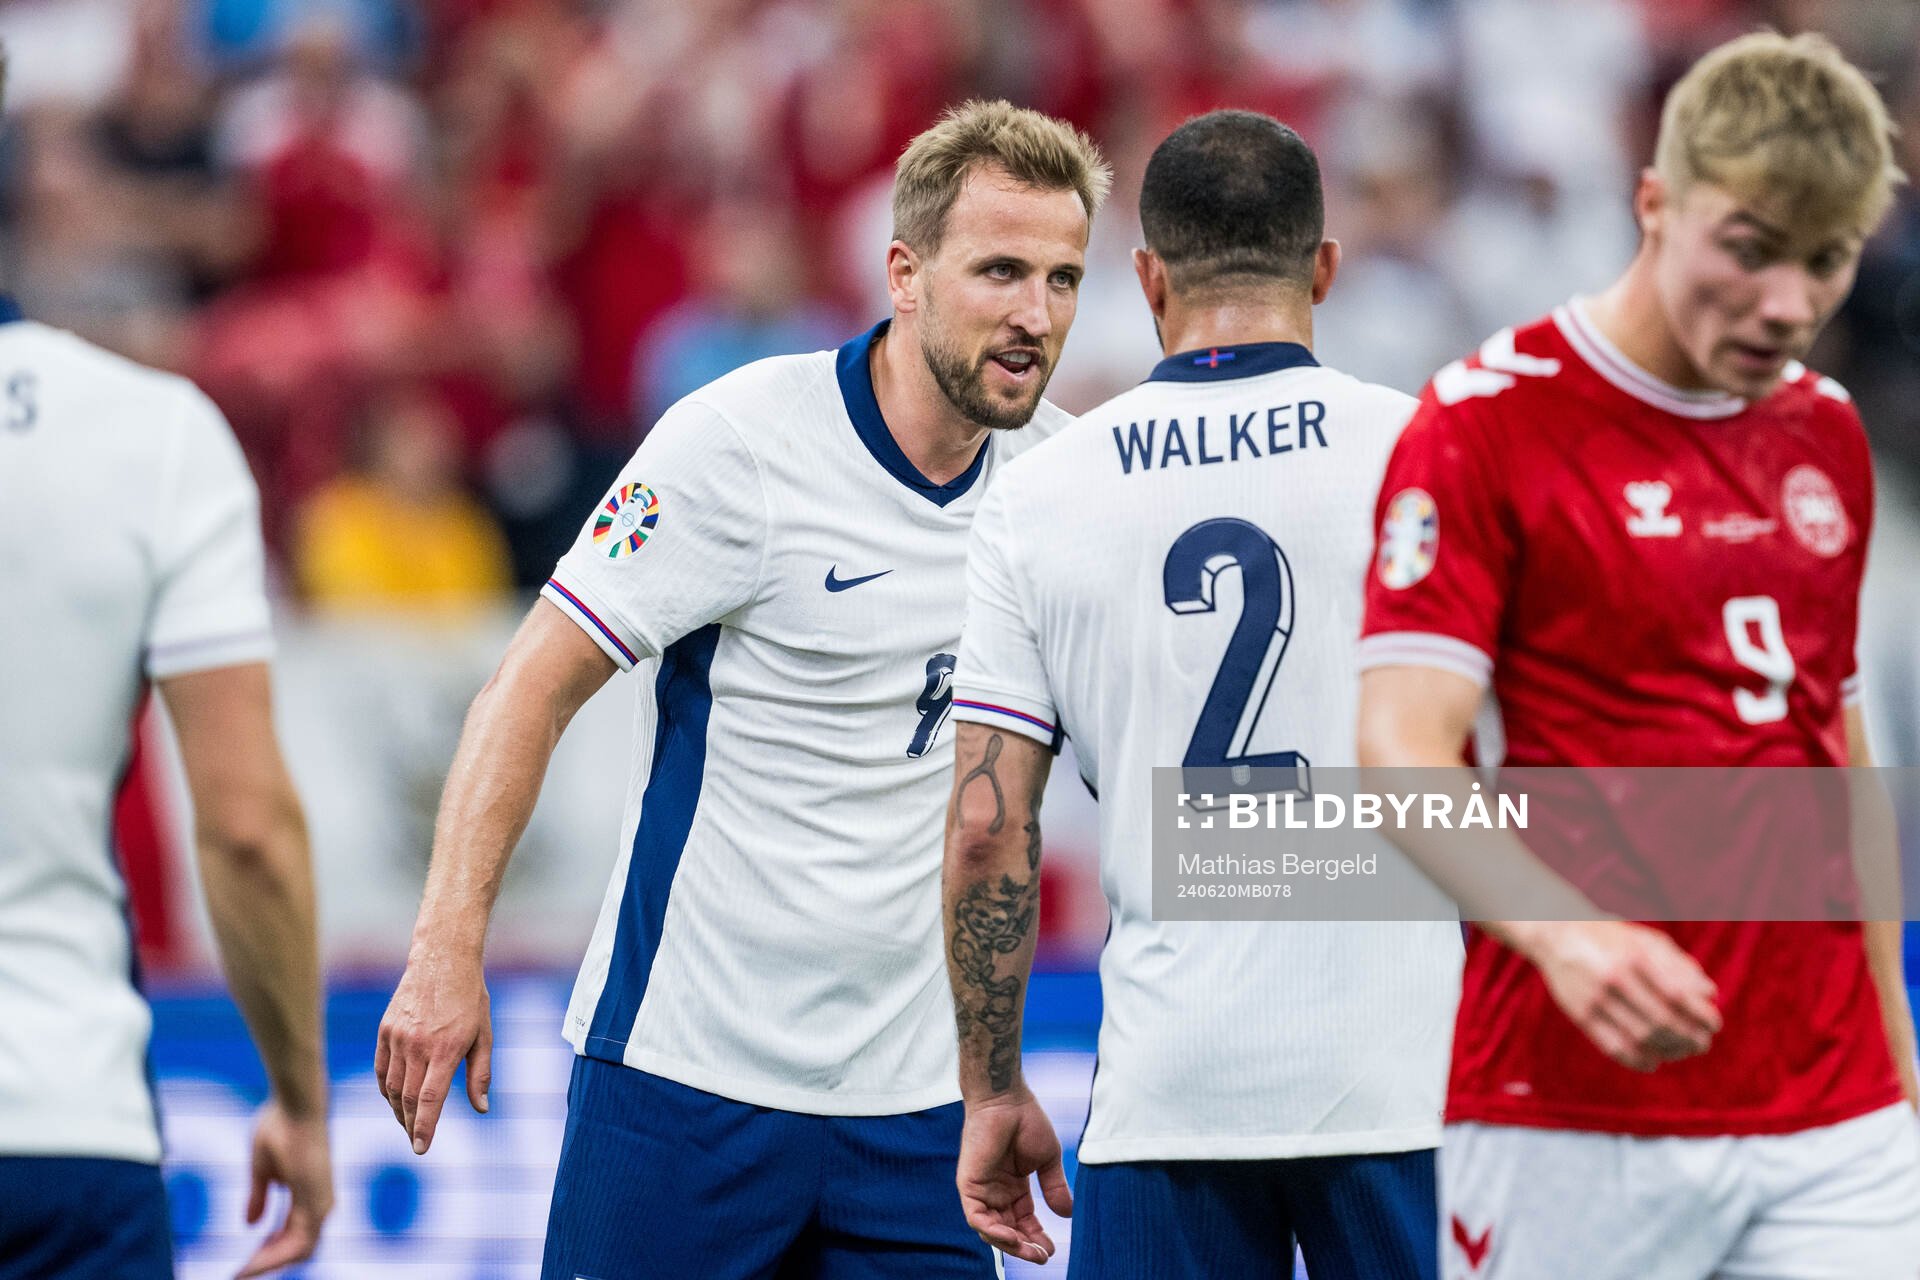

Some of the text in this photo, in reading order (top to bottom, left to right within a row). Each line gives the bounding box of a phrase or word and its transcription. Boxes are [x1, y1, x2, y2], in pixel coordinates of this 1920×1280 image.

[1112, 400, 1329, 475] WALKER
[1163, 517, 1313, 813] 2
[1722, 595, 1796, 724] 9
